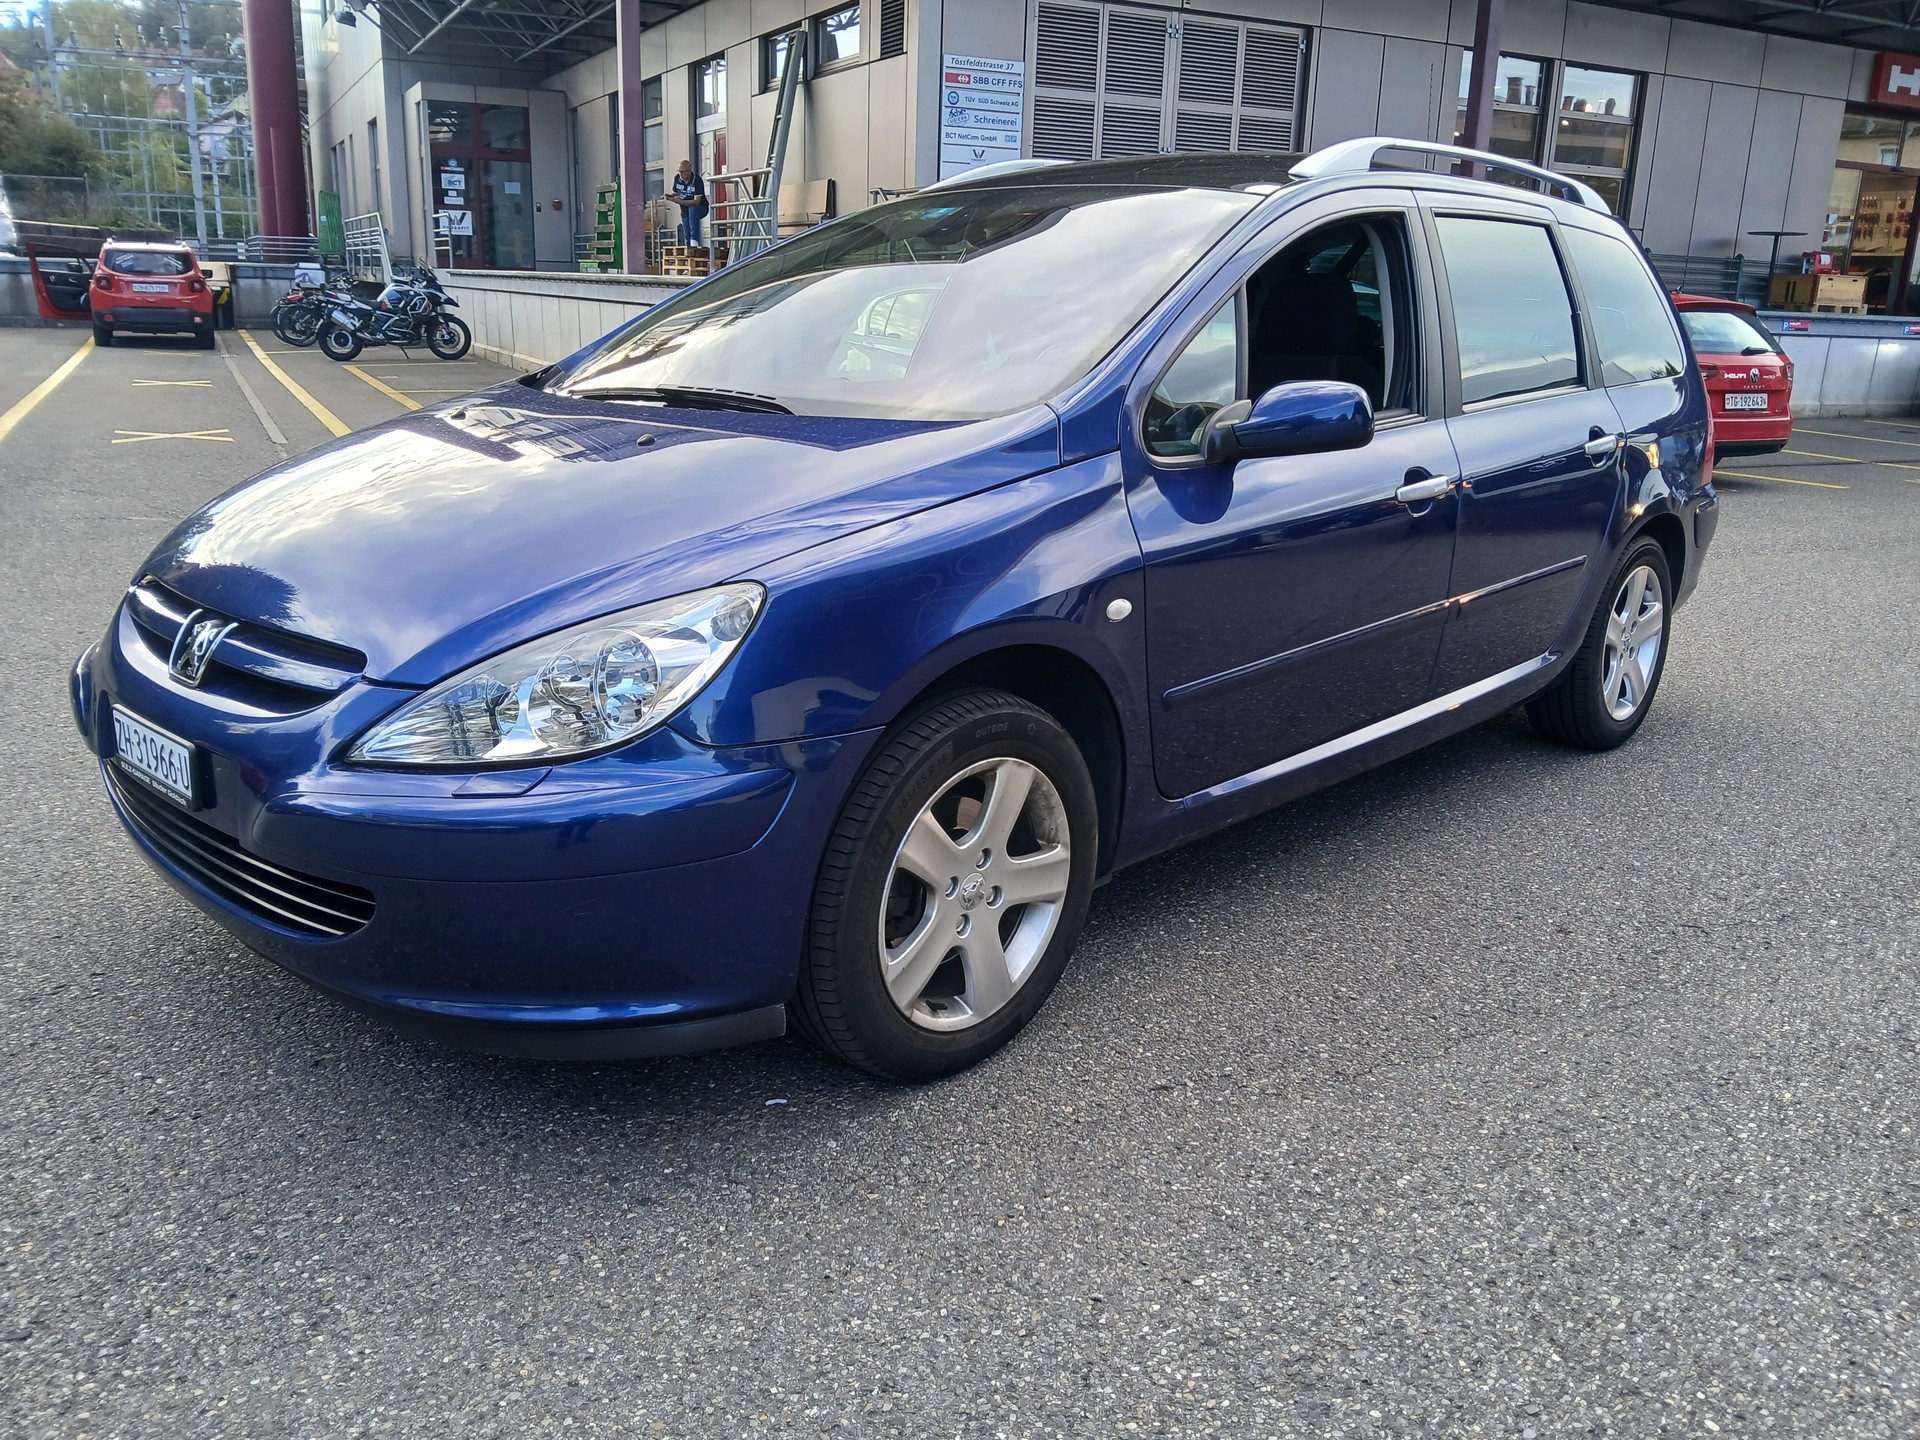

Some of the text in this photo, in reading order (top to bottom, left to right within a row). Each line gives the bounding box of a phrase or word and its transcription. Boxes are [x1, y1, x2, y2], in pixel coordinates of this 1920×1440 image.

[951, 58, 1003, 69] Tössfeldstrasse
[973, 76, 1023, 88] SBB CFF FFS
[974, 115, 1017, 126] Schreinerei
[975, 722, 1009, 738] OUTSIDE
